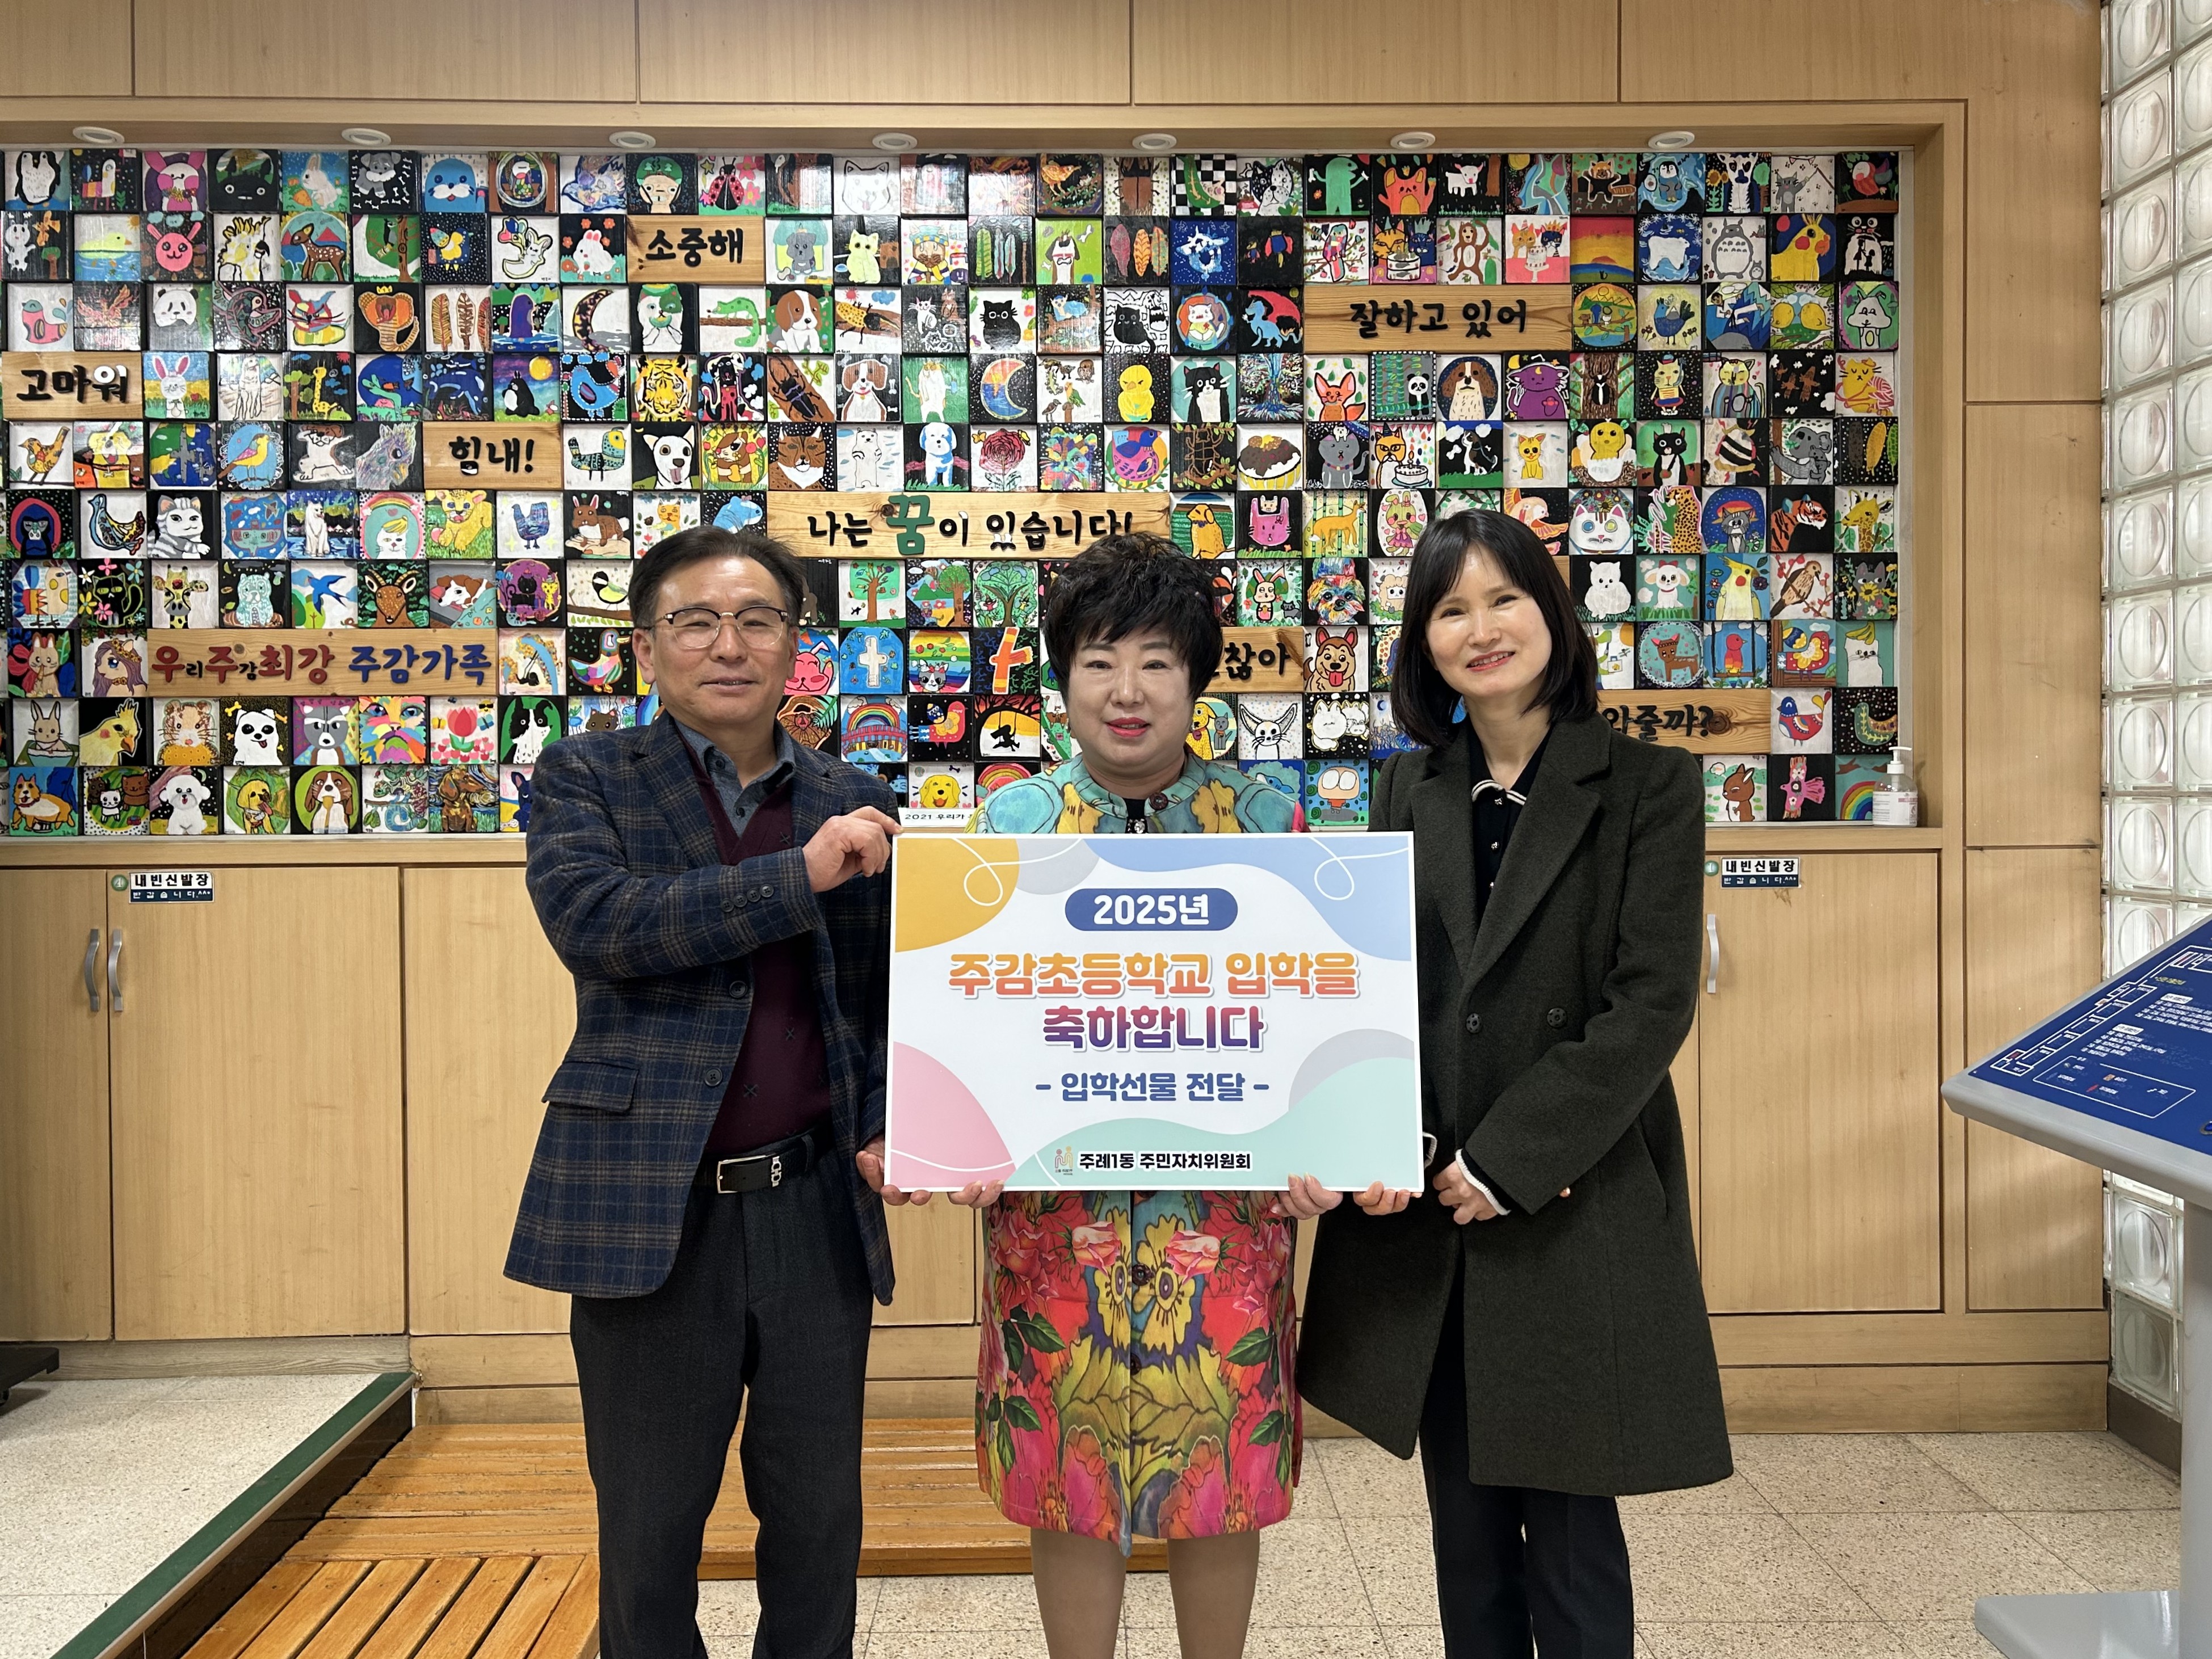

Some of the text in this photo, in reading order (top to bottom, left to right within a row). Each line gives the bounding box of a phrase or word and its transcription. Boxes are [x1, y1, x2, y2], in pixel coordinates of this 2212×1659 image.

[646, 228, 743, 267] 소중해
[1349, 299, 1526, 338] 잘하고 있어
[16, 364, 128, 404] 고마워
[448, 435, 535, 475] 힘내!
[807, 494, 1133, 555] 나는 꿈이 있습니다!
[348, 644, 493, 686] 주감가족
[1212, 642, 1290, 680] 찮아
[134, 873, 209, 887] 내빈신발장
[1726, 860, 1795, 873] 내빈신발장
[1093, 893, 1210, 926] 2025년
[948, 951, 1357, 996] 주감초등학교 입학을
[1042, 1005, 1265, 1049] 축하합니다
[1061, 1072, 1176, 1102] 입학선물
[1186, 1072, 1246, 1102] 전달
[1079, 1153, 1251, 1169] 주례1동 주민자치위원회
